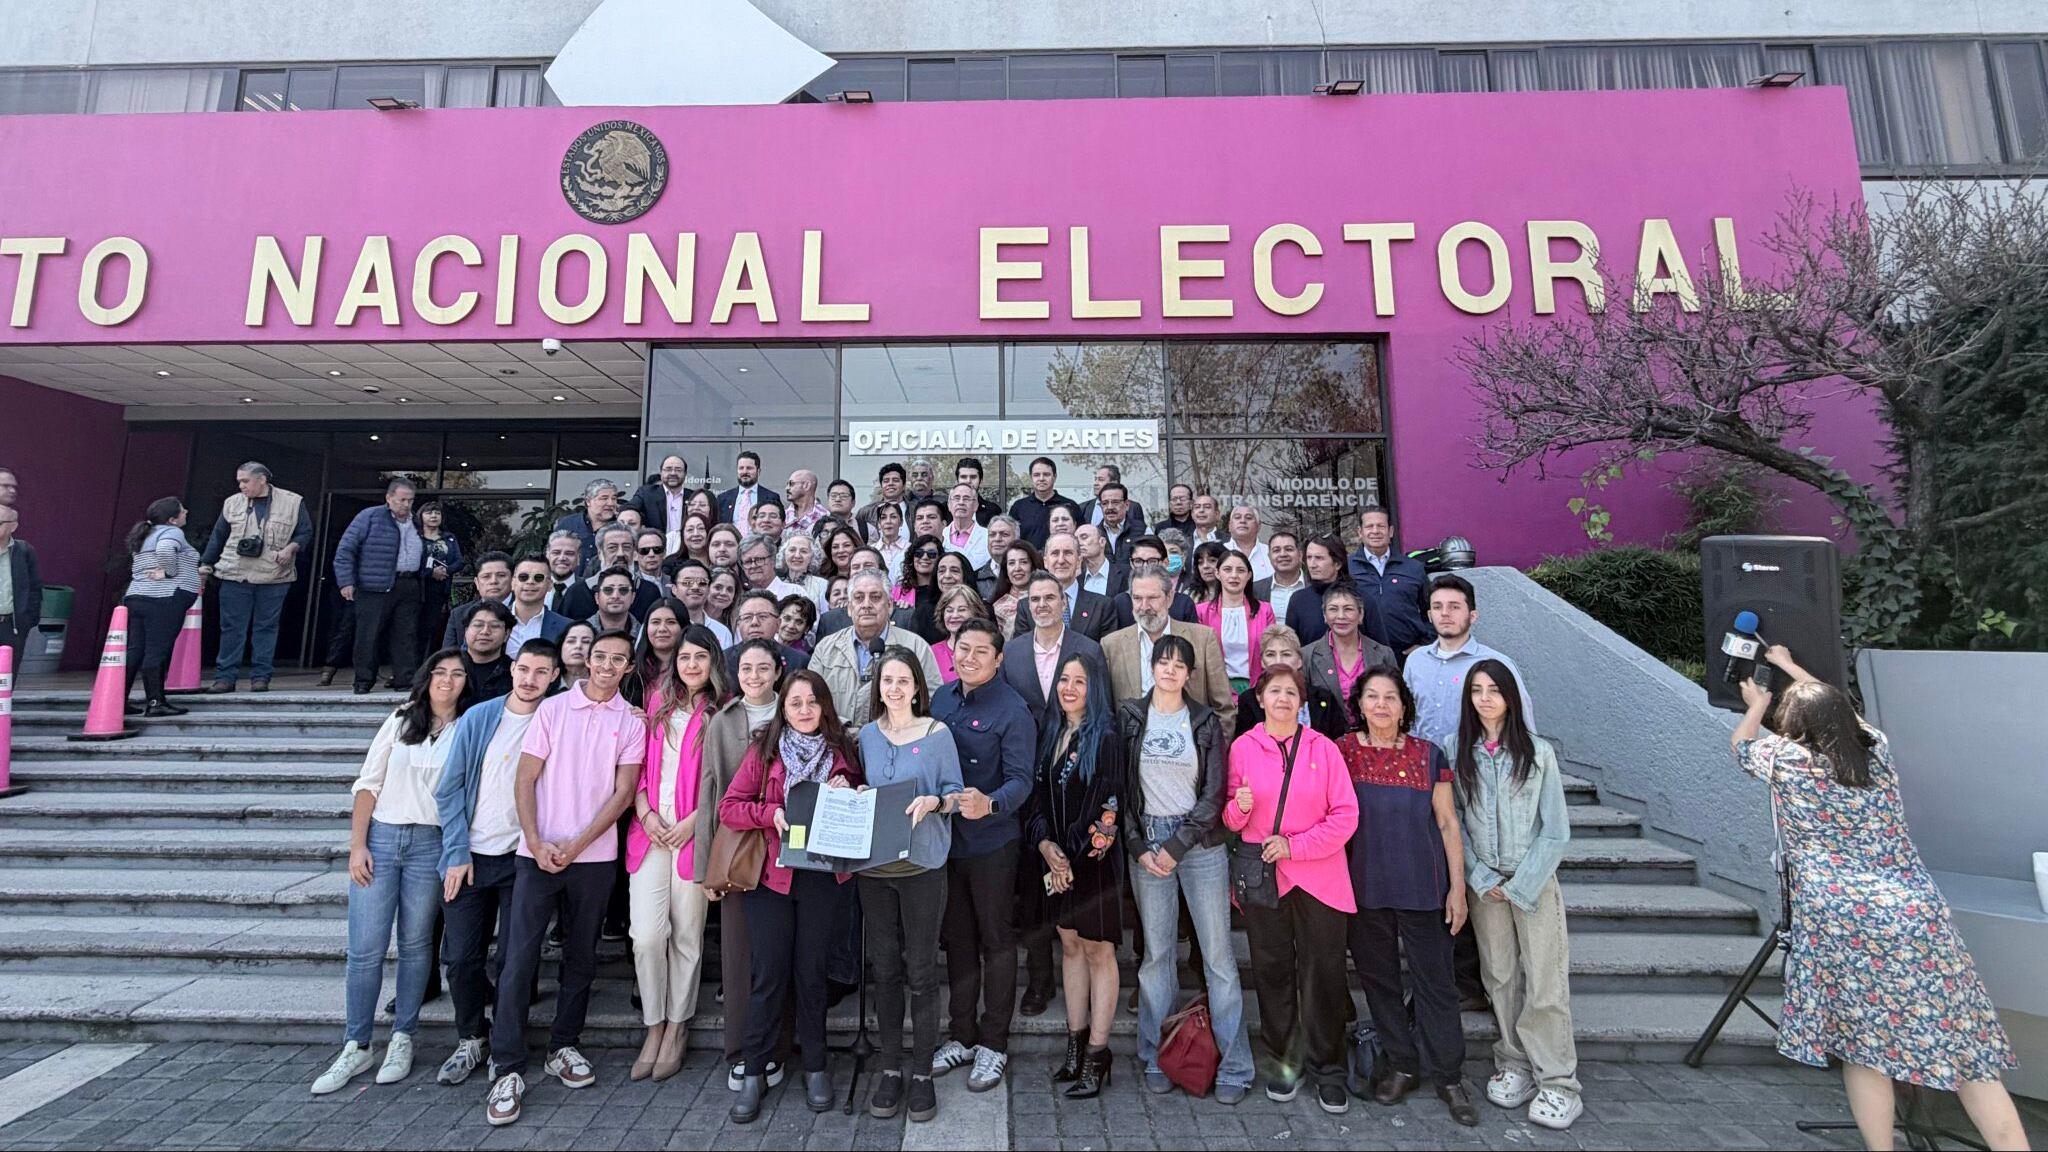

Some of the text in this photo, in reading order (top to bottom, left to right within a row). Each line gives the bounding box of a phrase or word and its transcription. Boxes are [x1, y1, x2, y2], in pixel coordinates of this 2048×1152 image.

[562, 121, 667, 174] ESTADOS UNIDOS MEXICANOS
[244, 230, 870, 327] NACIONAL
[979, 217, 1798, 319] ELECTORAL
[853, 424, 1154, 451] OFICIALÍA DE PARTES
[1276, 474, 1378, 491] MÓDULO DE
[1218, 493, 1379, 508] TRANSPARENCIA
